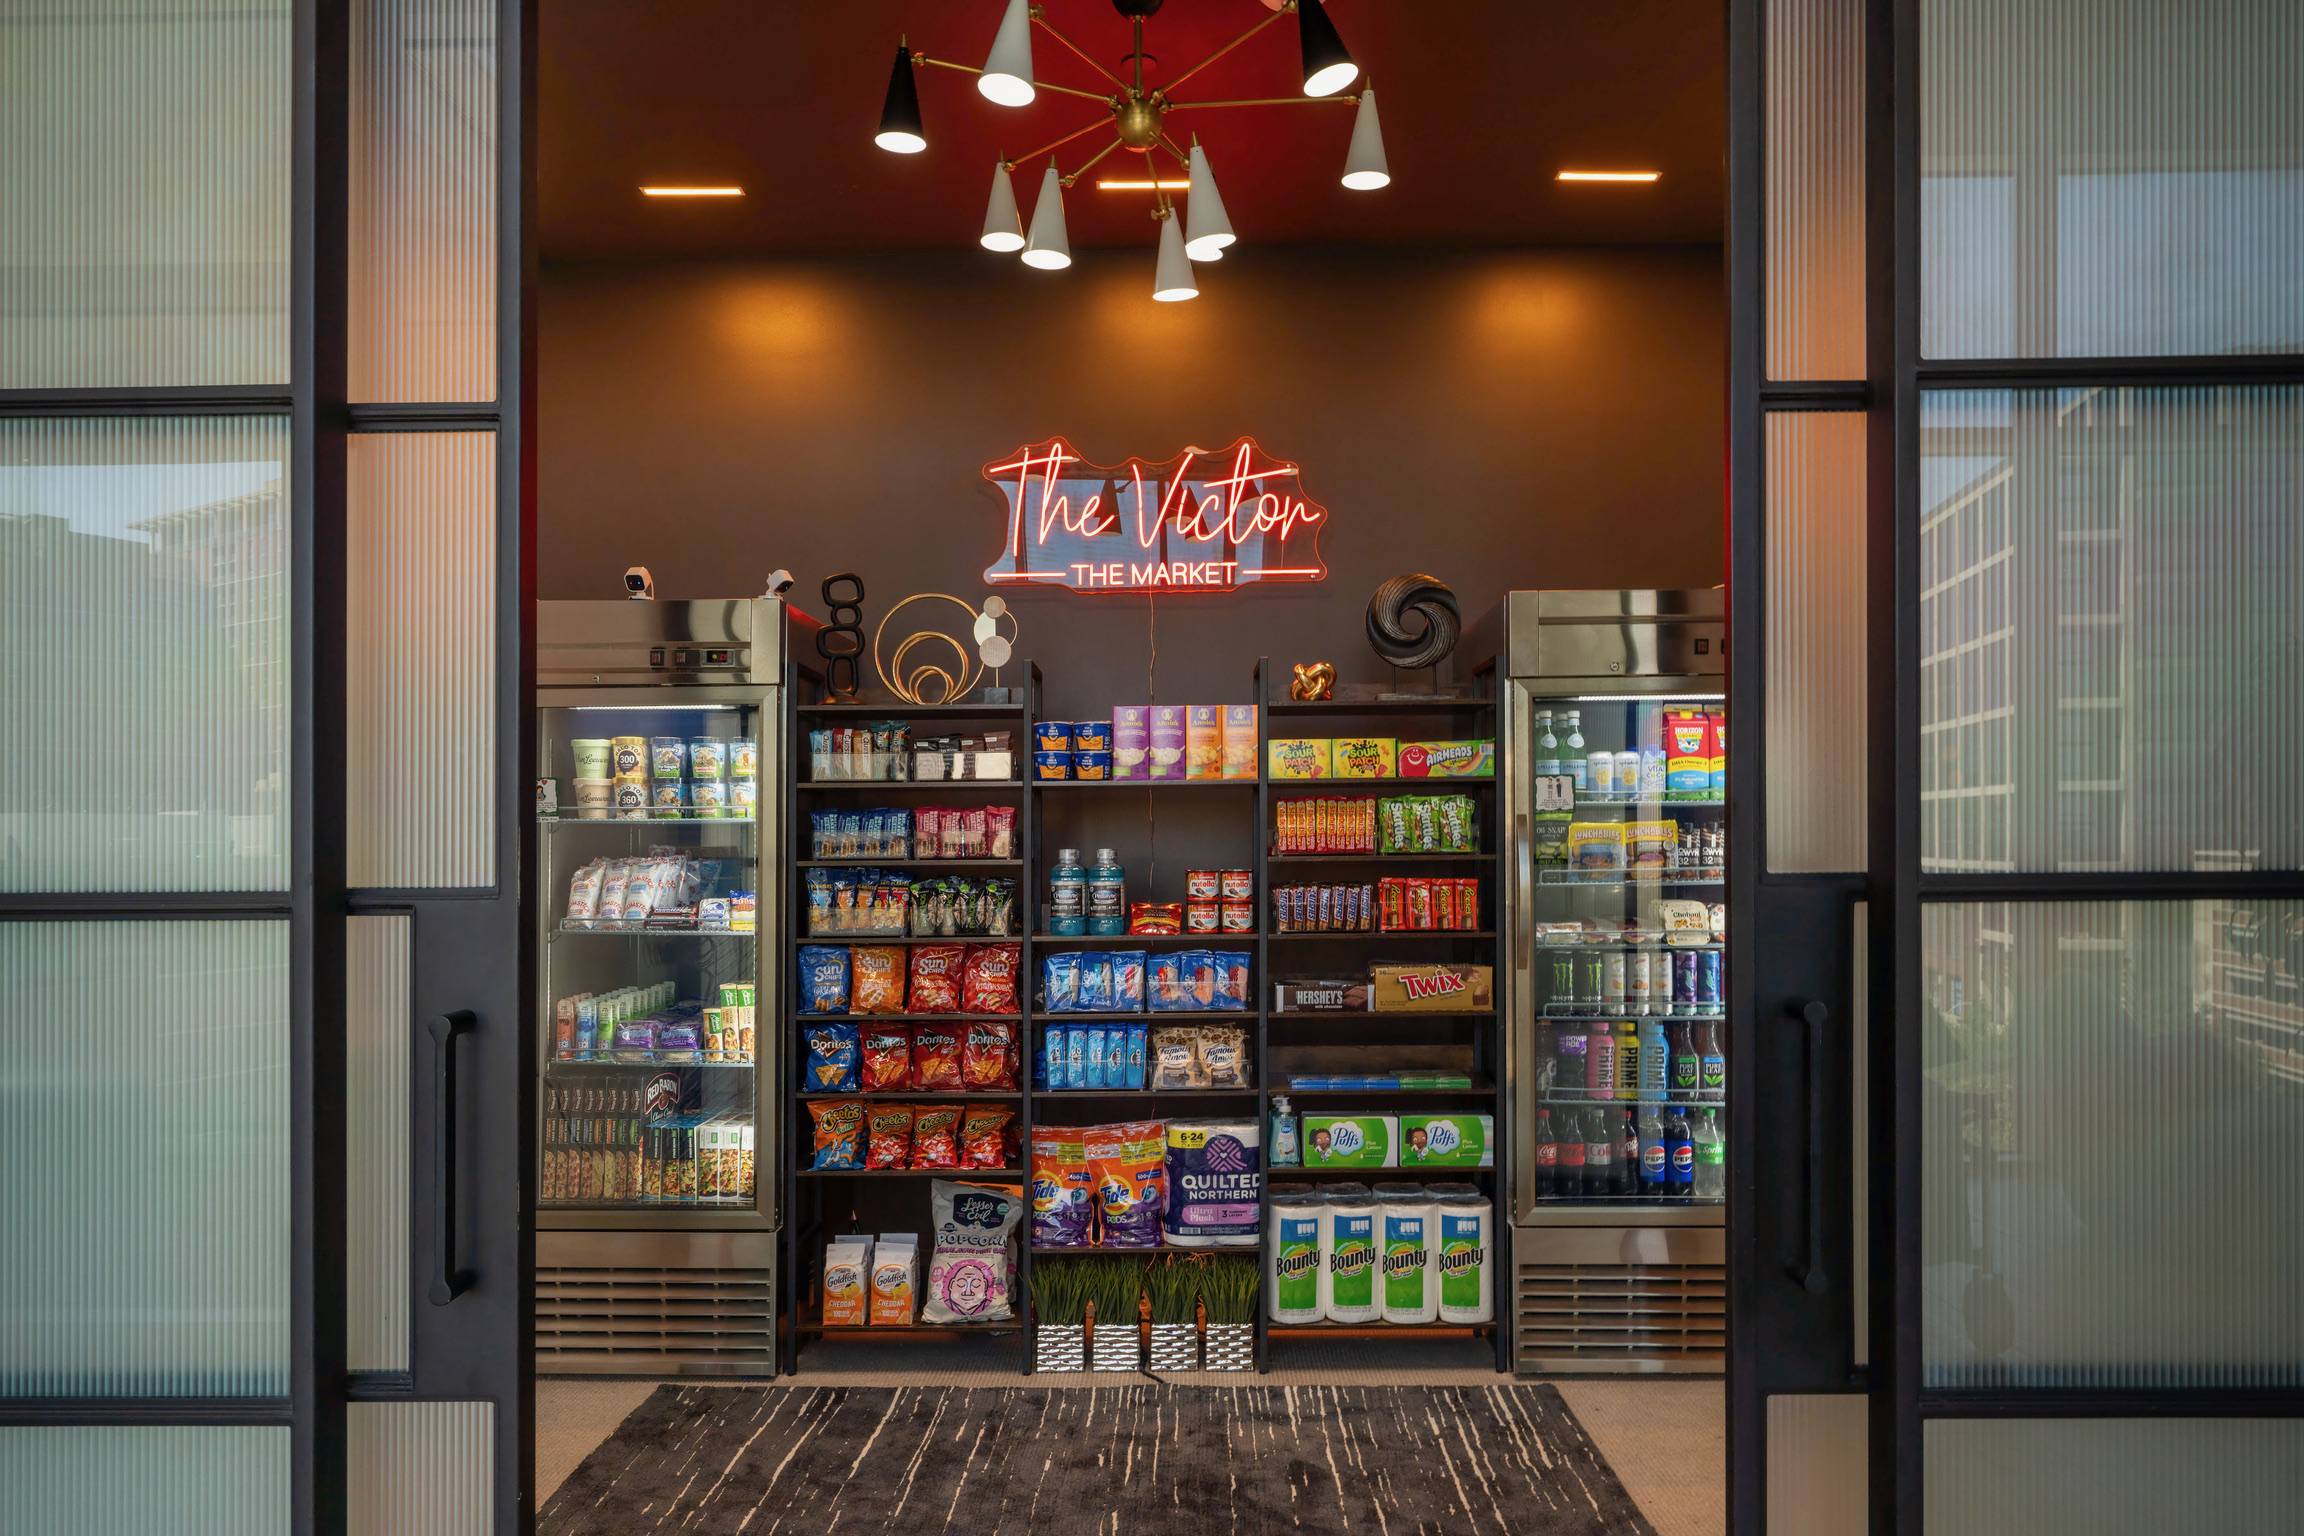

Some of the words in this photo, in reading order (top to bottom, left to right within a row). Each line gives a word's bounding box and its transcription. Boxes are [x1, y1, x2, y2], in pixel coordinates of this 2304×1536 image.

[989, 443, 1115, 557] The
[1132, 443, 1321, 548] Victor
[1070, 563, 1124, 586] THE
[1131, 561, 1239, 586] MARKET
[616, 745, 629, 756] HALO
[631, 746, 641, 757] TOP
[1285, 748, 1313, 758] SOUR
[1349, 747, 1378, 757] SOUR
[1426, 746, 1473, 767] AIRHEADS
[620, 755, 635, 764] 300
[1284, 757, 1315, 767] PATCH
[1349, 756, 1380, 767] PATCH
[617, 786, 631, 797] HALO
[633, 787, 643, 797] TOP
[621, 796, 637, 804] 360
[1391, 802, 1406, 849] Skittles
[1419, 804, 1434, 850] Skittles
[1445, 802, 1462, 847] Skittles
[1547, 826, 1565, 834] SNAP!
[1627, 826, 1673, 838] LUNCHABLES
[1575, 829, 1620, 841] LUNCHABLES
[1678, 848, 1699, 856] OWYN
[1702, 847, 1724, 856] OWYN
[1678, 857, 1689, 865] 32
[1702, 857, 1713, 865] 32
[1280, 890, 1288, 921] SATISFIES
[1308, 888, 1317, 920] SATISFIES
[1335, 888, 1344, 920] SNICKERS
[1348, 889, 1358, 921] SATISFIES
[862, 956, 890, 974] Sun
[919, 957, 947, 975] Sun
[929, 967, 945, 975] CHIPS
[979, 960, 1007, 977] Sun
[814, 964, 843, 982] Sun
[990, 969, 1008, 977] CHIPS
[1400, 969, 1465, 999] Twix
[1297, 990, 1343, 1005] HERSHEY'S
[811, 1039, 852, 1049] Doritos
[866, 1036, 906, 1049] Doritos
[917, 1035, 955, 1046] Doritos
[968, 1034, 1006, 1045] Doritos
[1158, 1046, 1191, 1058] Famous
[1202, 1046, 1236, 1061] Famous
[1598, 1046, 1614, 1088] PRIME
[1620, 1047, 1638, 1089] PRIME
[1647, 1046, 1665, 1091] PRIME
[647, 1083, 659, 1103] RED
[660, 1079, 677, 1095] BARON
[822, 1105, 860, 1132] Cheetos
[873, 1113, 908, 1131] Cheetos
[917, 1113, 953, 1132] Cheetos
[1334, 1127, 1359, 1147] Puffs
[1430, 1126, 1455, 1147] Puffs
[1703, 1146, 1723, 1155] Sprite
[1182, 1173, 1260, 1190] QUILTED
[1032, 1180, 1059, 1200] Tide
[1101, 1184, 1129, 1207] Tide
[1189, 1190, 1257, 1200] NORTHERN
[960, 1197, 994, 1213] Lesser
[966, 1208, 990, 1223] Evil
[1033, 1211, 1053, 1219] PODS
[1107, 1215, 1128, 1224] PODS
[1190, 1214, 1214, 1222] Plush
[1222, 1210, 1227, 1218] 3
[937, 1233, 1007, 1247] POPCORN
[1277, 1249, 1320, 1277] Bounty
[1330, 1246, 1376, 1273] Bounty
[1382, 1249, 1427, 1274] Bounty
[1439, 1247, 1484, 1273] Bounty
[827, 1272, 857, 1288] Goldfish
[876, 1272, 907, 1287] Goldfish
[828, 1299, 856, 1308] CHEDDAR
[877, 1299, 905, 1307] CHEDDAR
